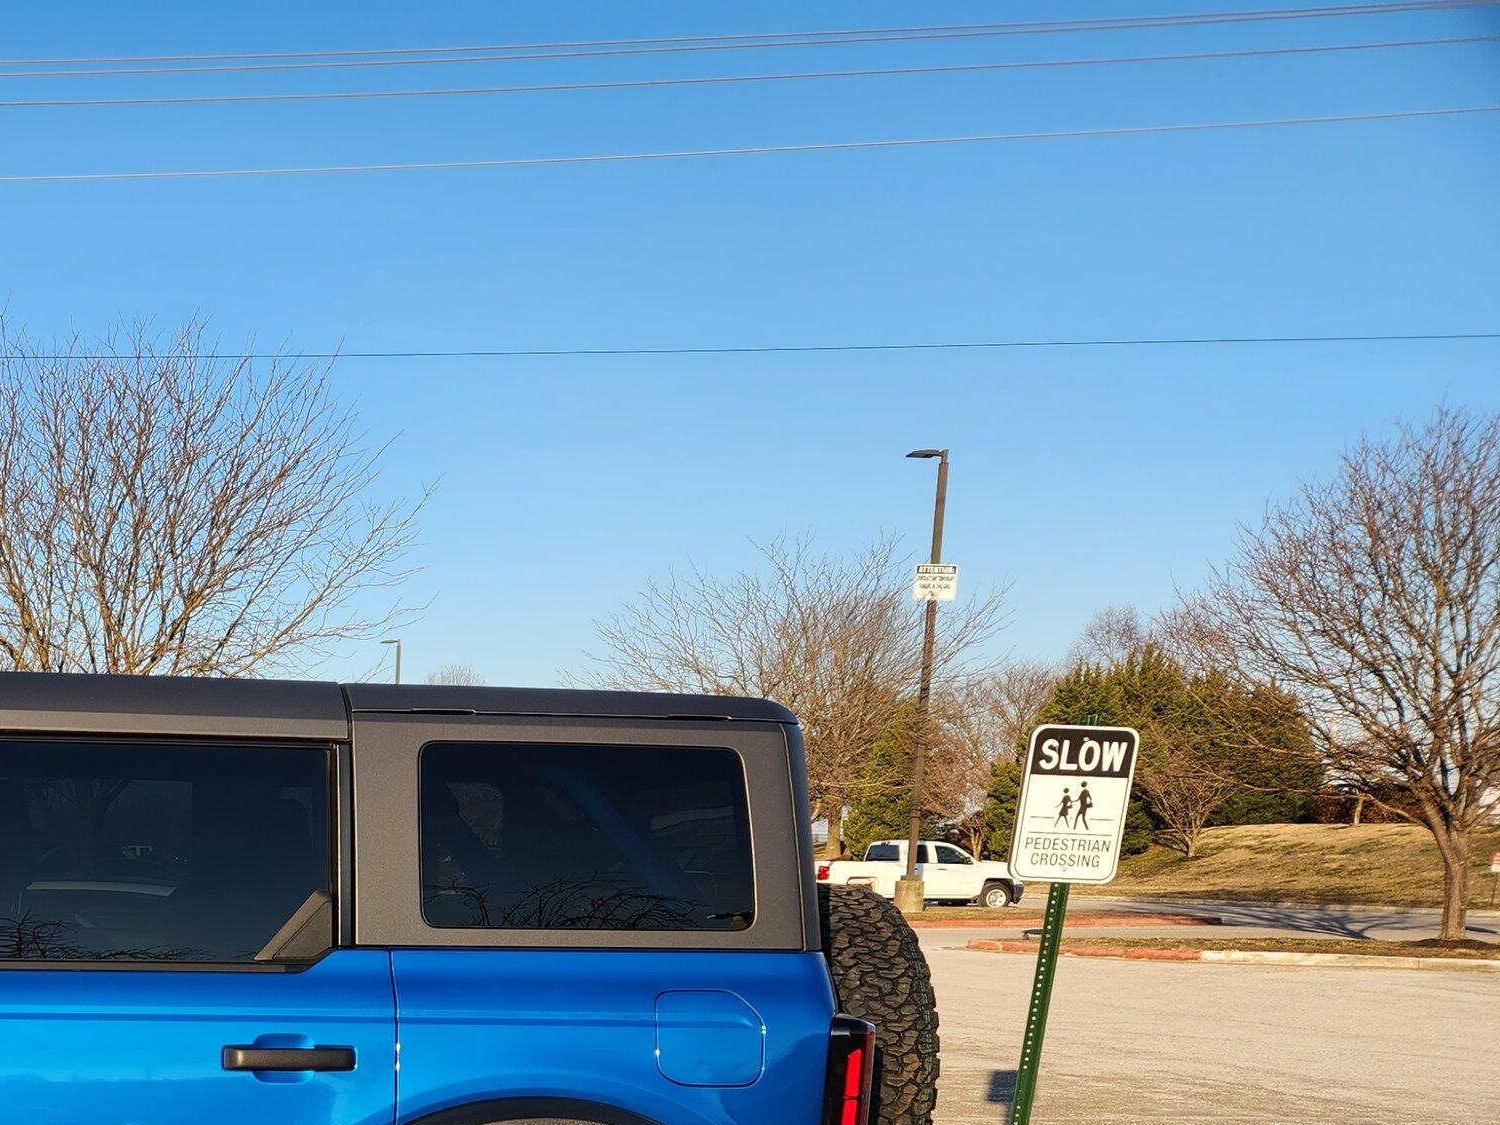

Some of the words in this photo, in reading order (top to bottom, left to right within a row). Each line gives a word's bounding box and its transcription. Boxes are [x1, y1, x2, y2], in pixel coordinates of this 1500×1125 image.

[1039, 738, 1128, 772] SLOW
[1025, 836, 1111, 853] PEDESTRIAN
[1030, 852, 1100, 868] CROSSING
